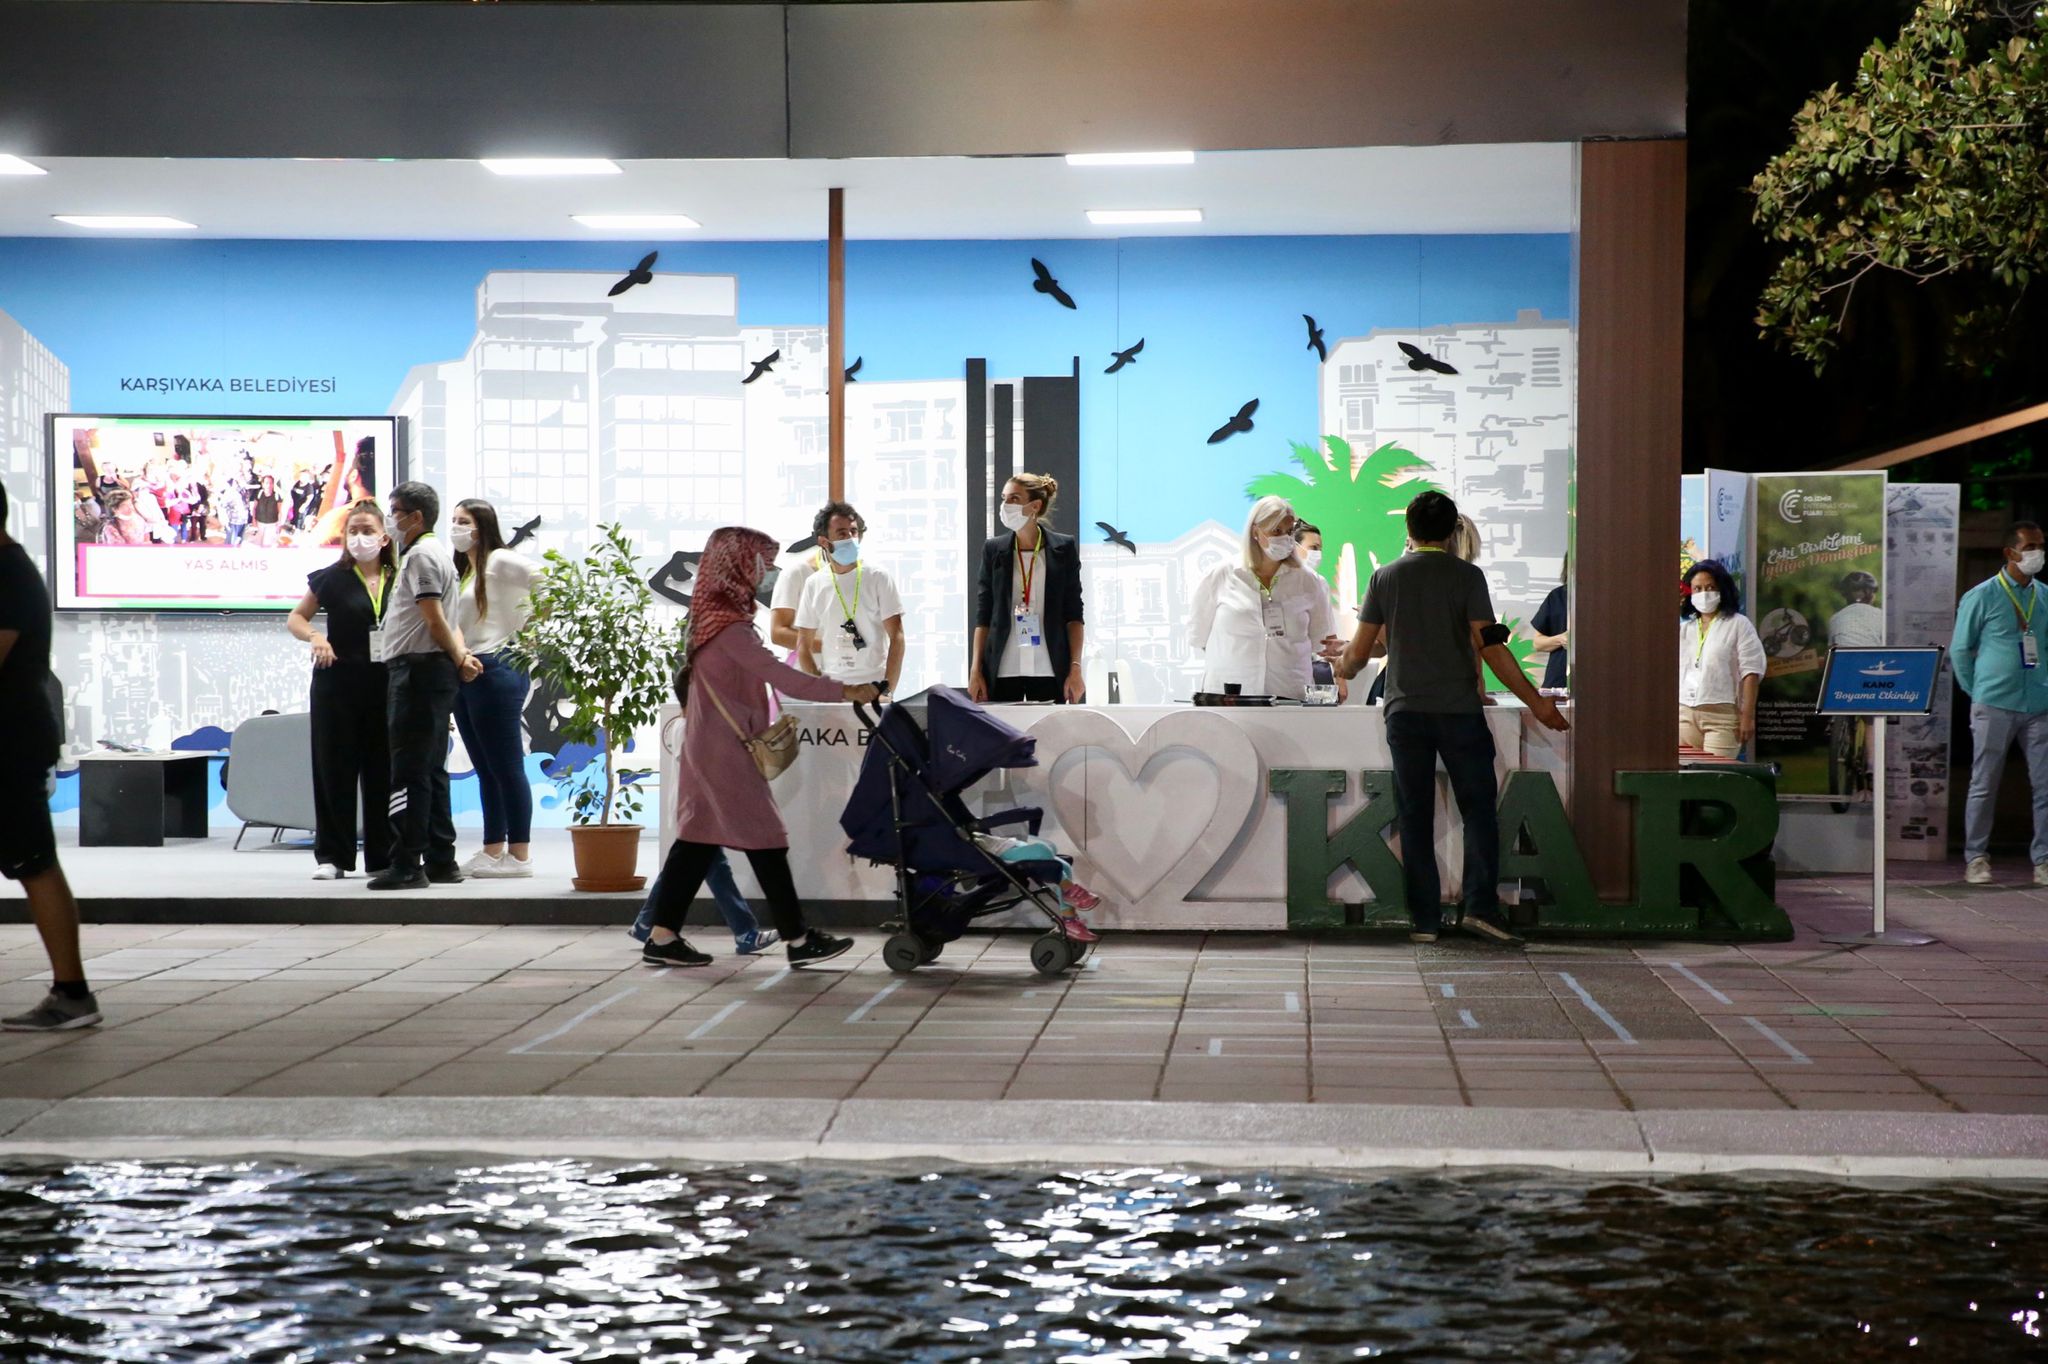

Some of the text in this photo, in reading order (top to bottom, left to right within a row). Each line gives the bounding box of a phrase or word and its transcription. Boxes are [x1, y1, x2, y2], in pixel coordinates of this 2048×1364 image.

[120, 376, 336, 395] KARŞIYAKA BELEDİYESİ
[1767, 547, 1799, 564] Eski
[1862, 680, 1896, 689] KANO
[1834, 690, 1920, 703] Boyama Etkinliği
[796, 728, 849, 746] AKA
